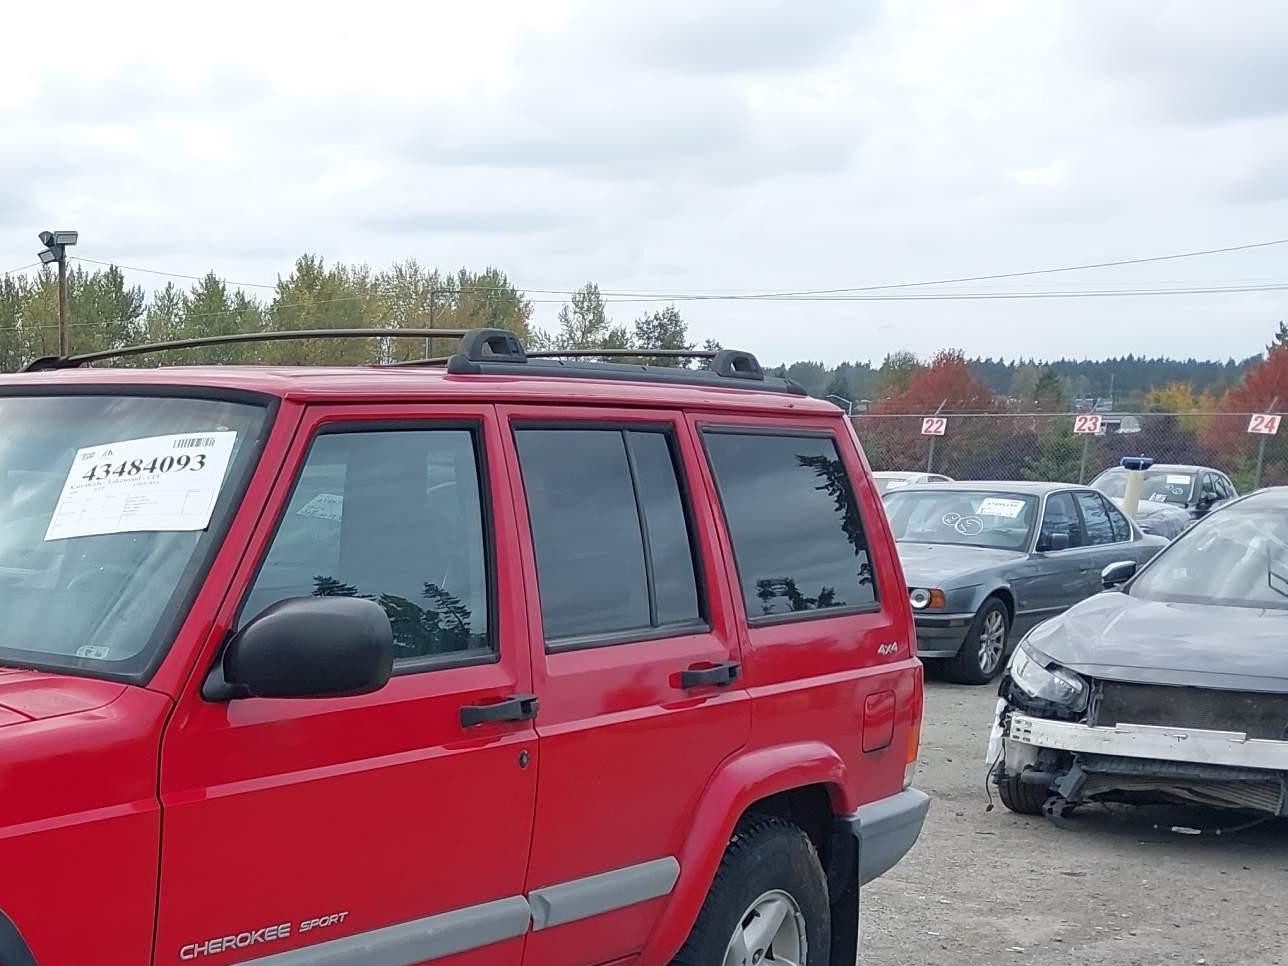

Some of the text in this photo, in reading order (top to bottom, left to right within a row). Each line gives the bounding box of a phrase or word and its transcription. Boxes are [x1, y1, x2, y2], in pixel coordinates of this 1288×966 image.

[923, 418, 944, 433] 22
[1076, 416, 1099, 431] 23
[1251, 415, 1276, 432] 24
[82, 453, 206, 481] 43484093
[179, 911, 349, 961] CHEROKEE SPORT
